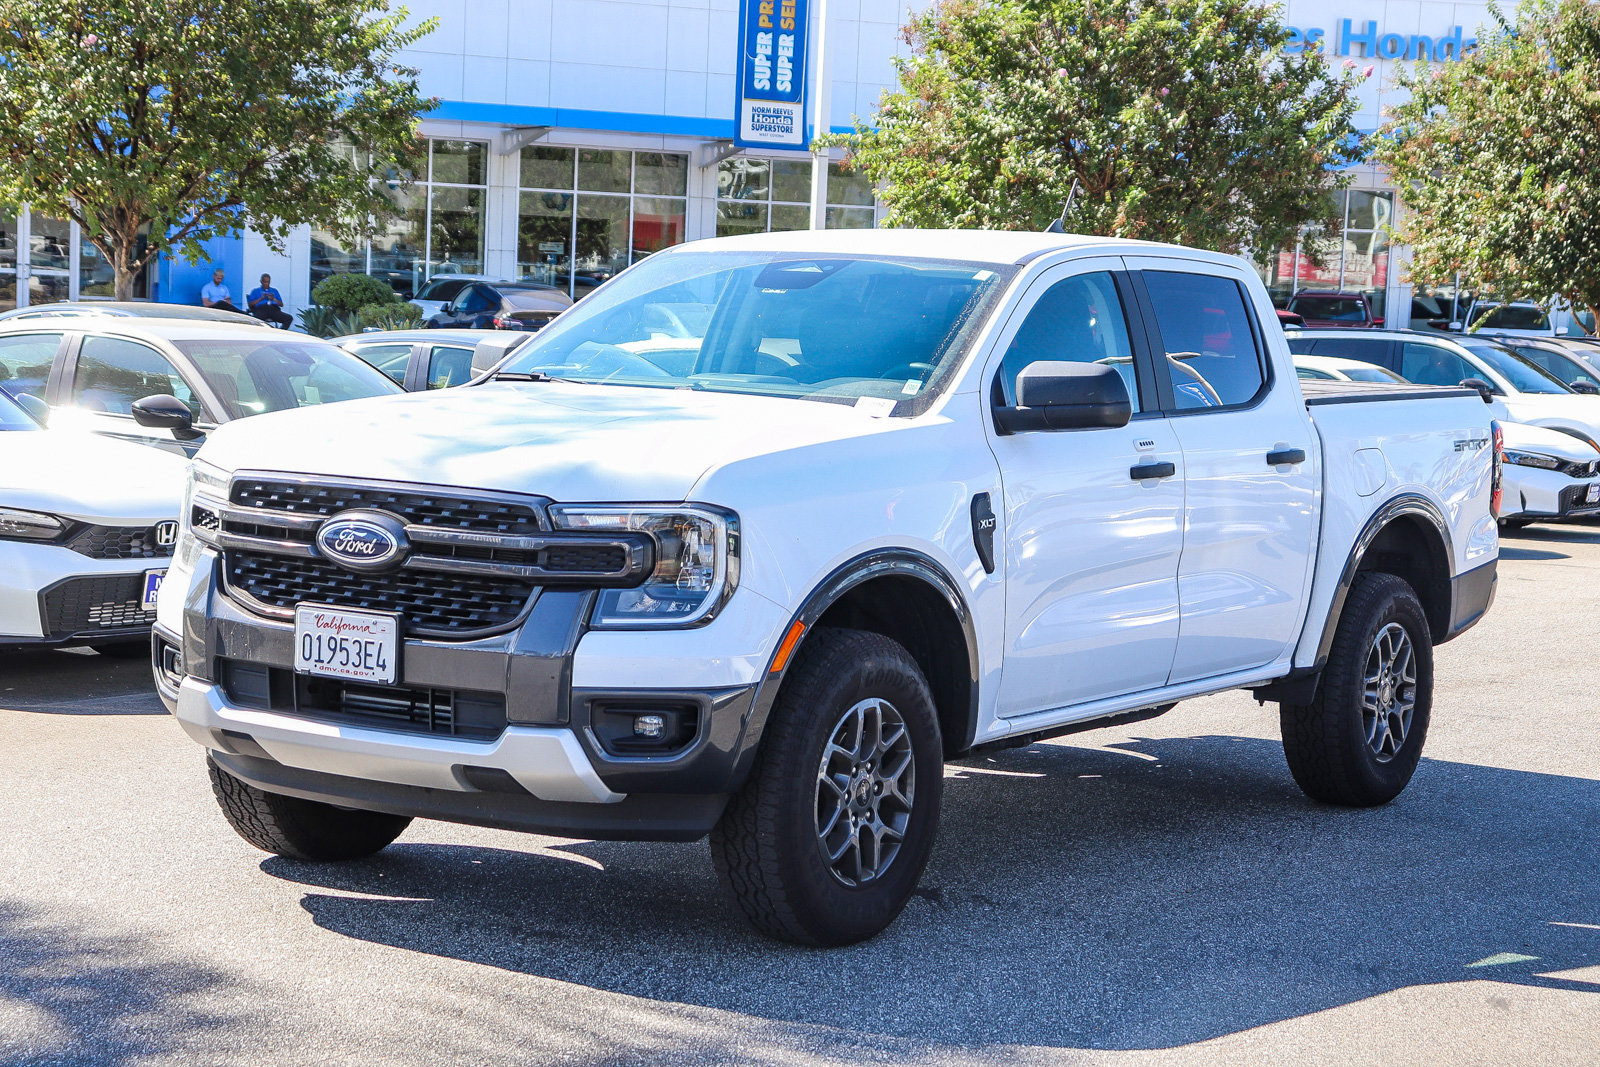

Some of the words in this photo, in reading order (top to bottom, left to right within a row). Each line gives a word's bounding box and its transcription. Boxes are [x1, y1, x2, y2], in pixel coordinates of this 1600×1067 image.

[759, 0, 774, 28] PR
[754, 31, 773, 90] SUPER
[776, 34, 794, 92] SUPER
[751, 123, 793, 133] SUPERSTORE
[753, 113, 792, 125] Honda
[1453, 438, 1489, 452] SPORT
[979, 518, 995, 529] XLT
[334, 528, 376, 555] Ford
[316, 613, 376, 635] California
[302, 632, 387, 672] 01953E4
[319, 665, 370, 677] dmv.ca.gov
